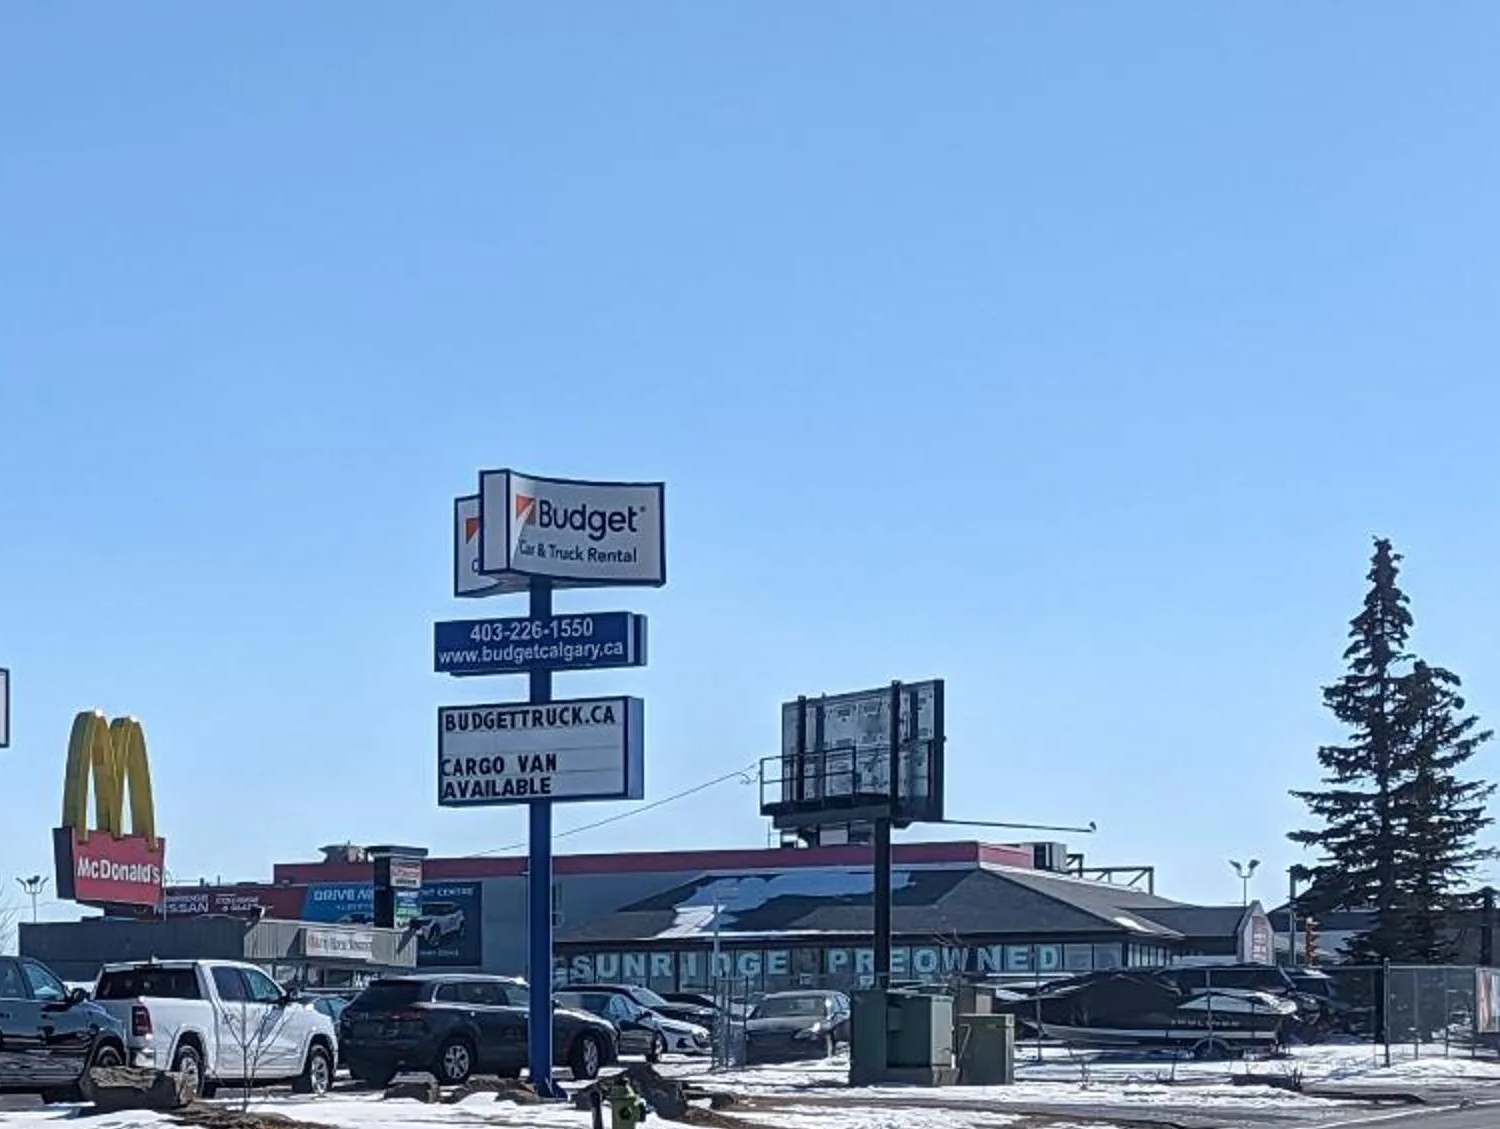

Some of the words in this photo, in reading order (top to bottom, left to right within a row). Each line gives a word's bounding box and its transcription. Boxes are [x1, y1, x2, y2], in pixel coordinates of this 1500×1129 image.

[539, 499, 638, 541] Budget
[520, 539, 536, 555] Car
[537, 543, 546, 557] &
[549, 544, 583, 562] Truck
[587, 546, 637, 563] Rental
[469, 617, 594, 644] 403-226-1550
[438, 639, 624, 666] www.budgetcalgary.ca
[444, 705, 616, 732] BUDGETTRUCK.CA
[440, 756, 505, 777] CARGO
[517, 752, 558, 774] VAN
[441, 777, 552, 800] AVAILABLE
[77, 856, 161, 884] McDonald's
[571, 952, 788, 979] SUNRIDGE
